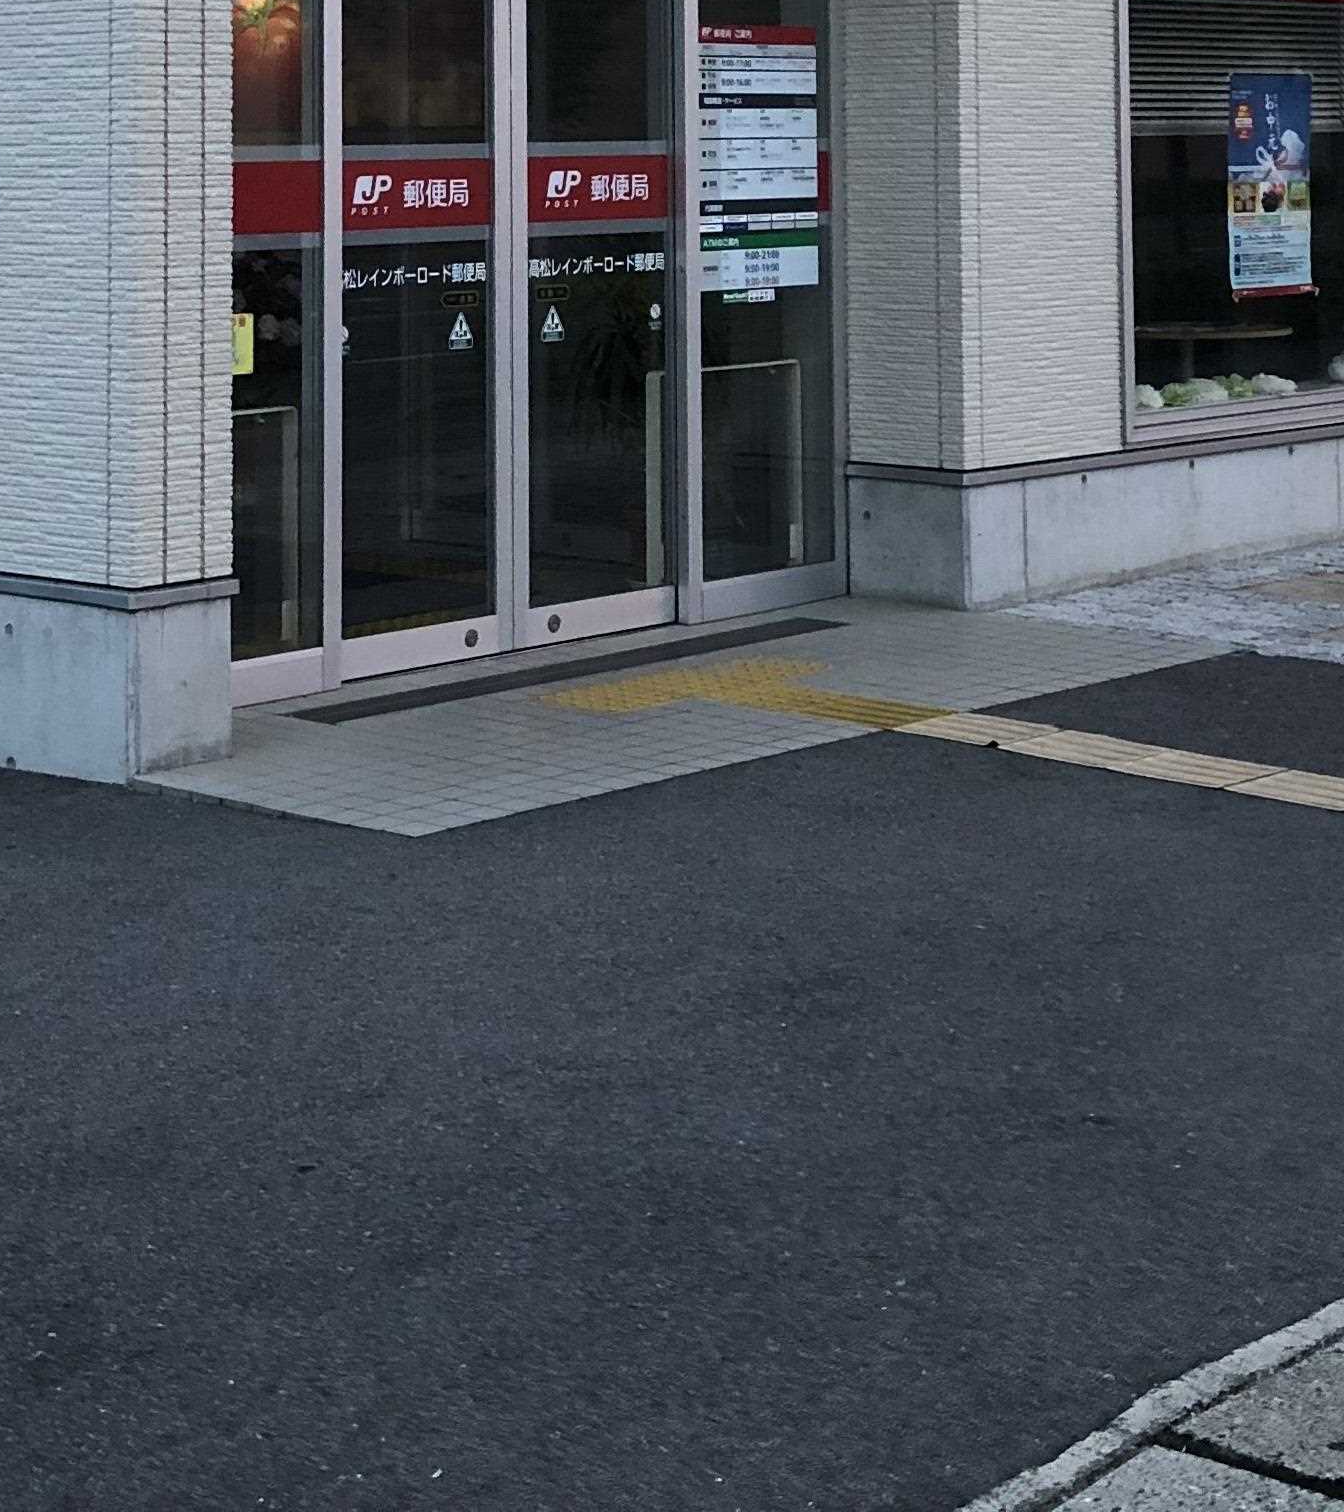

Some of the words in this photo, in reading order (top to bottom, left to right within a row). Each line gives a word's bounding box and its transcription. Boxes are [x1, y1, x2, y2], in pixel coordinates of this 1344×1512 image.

[353, 175, 393, 205] JP
[403, 179, 469, 208] 郵便局
[547, 170, 582, 198] JP
[590, 174, 649, 202] 郵便局
[351, 206, 390, 216] POST
[545, 199, 579, 208] POST
[528, 252, 665, 278] 高松レインボーロード郵便局
